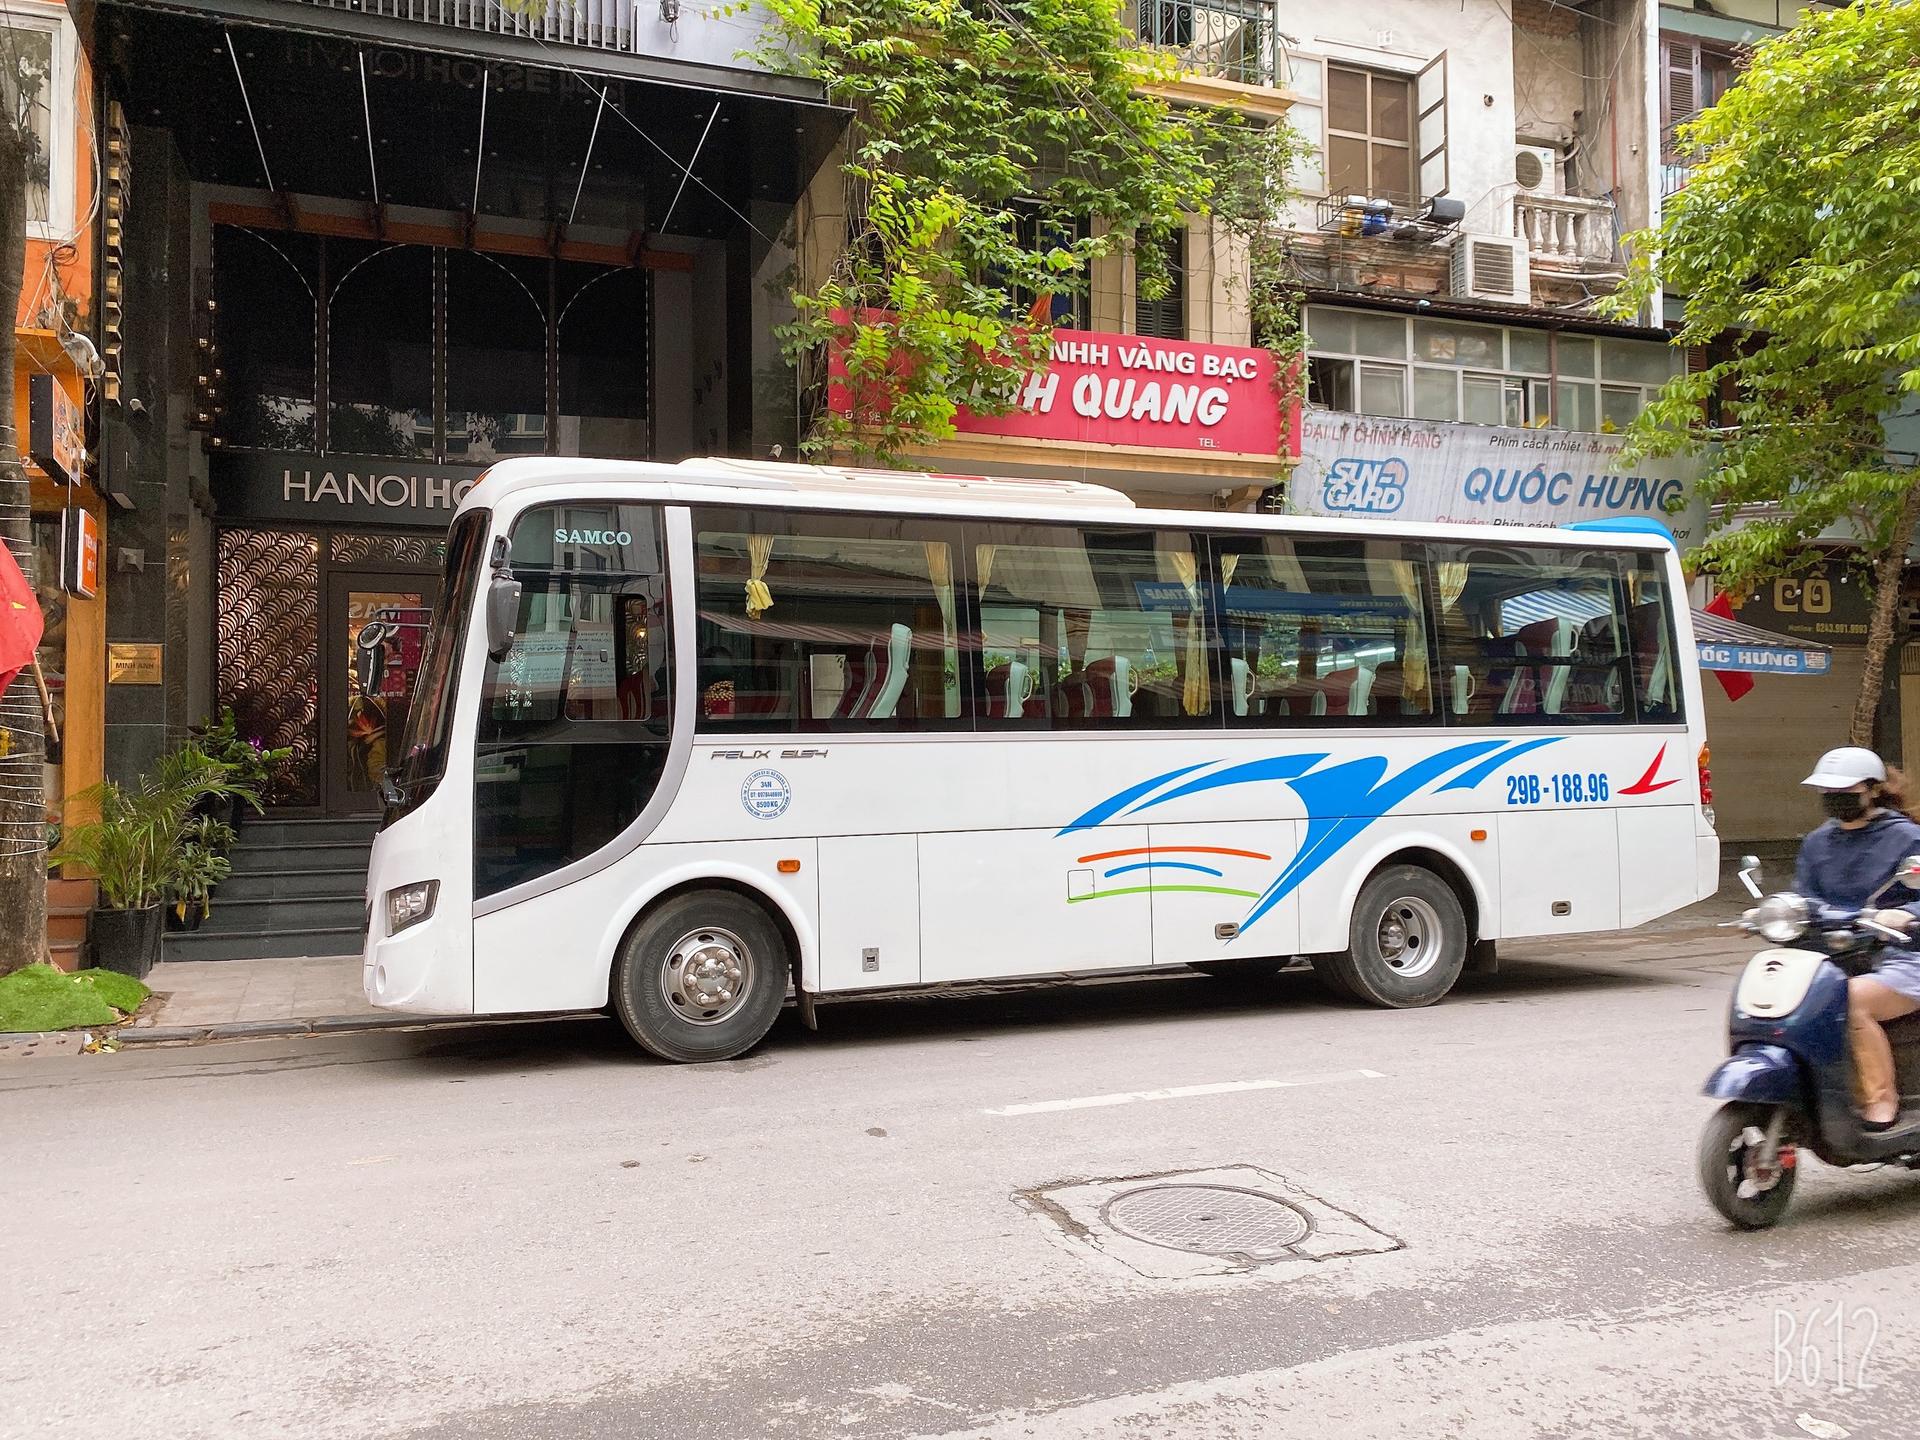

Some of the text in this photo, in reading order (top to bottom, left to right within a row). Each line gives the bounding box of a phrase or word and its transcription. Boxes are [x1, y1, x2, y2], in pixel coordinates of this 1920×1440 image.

[1117, 341, 1198, 376] VÀNG
[1202, 354, 1258, 385] BẠC
[1071, 373, 1230, 427] QUANG
[1198, 437, 1221, 449] TEL:
[1489, 435, 1519, 447] Phim
[1522, 437, 1549, 450] cách
[1552, 440, 1581, 452] nhiệt
[284, 470, 417, 507] HANOI
[1326, 485, 1403, 510] GARD
[1464, 463, 1684, 512] QUỐC HƯNG
[555, 528, 632, 546] SAMCO
[1696, 645, 1730, 663] ỐC
[1738, 651, 1798, 667] HƯNG
[711, 749, 771, 760] FELIX
